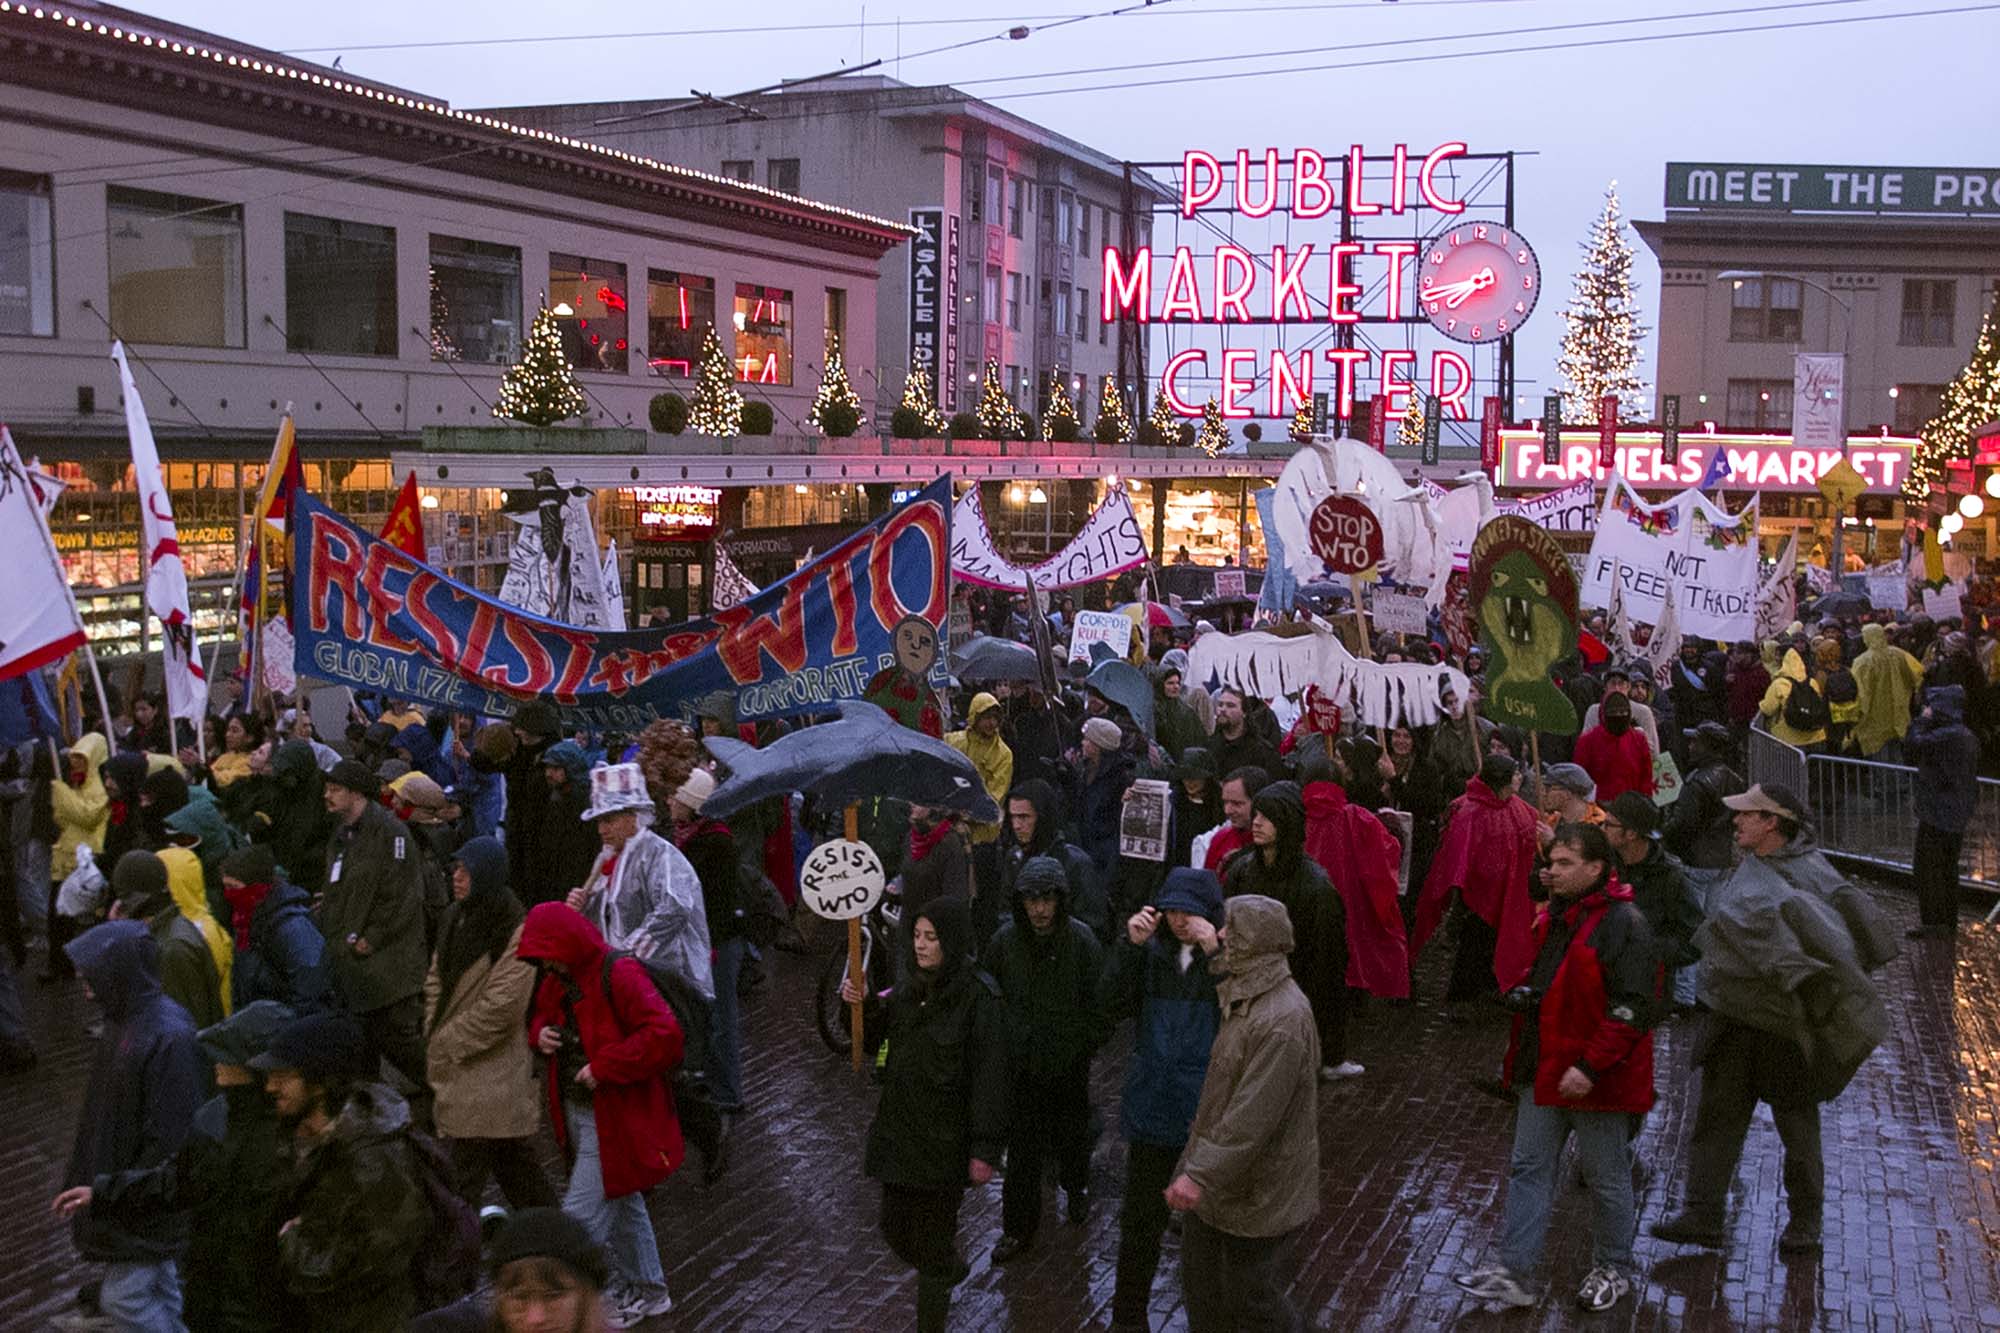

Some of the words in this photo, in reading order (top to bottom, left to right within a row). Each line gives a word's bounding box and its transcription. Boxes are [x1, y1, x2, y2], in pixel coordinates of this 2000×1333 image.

[1182, 142, 1467, 219] PUBLIC
[1687, 169, 1799, 203] MEET
[1824, 172, 1903, 205] THE
[915, 214, 936, 243] LA
[949, 217, 958, 247] LA
[1449, 232, 1460, 247] 11
[1473, 225, 1488, 240] 12
[1501, 231, 1508, 245] 1
[1430, 251, 1444, 264] 10
[1518, 249, 1528, 264] 2
[914, 249, 936, 322] SALLE
[948, 254, 958, 326] SALLE
[1101, 244, 1418, 323] MARKET
[1423, 275, 1434, 289] 9
[1523, 275, 1533, 290] 3
[1429, 301, 1439, 315] 8
[1514, 300, 1525, 313] 4
[1447, 319, 1457, 332] 7
[1471, 325, 1481, 339] 6
[1498, 318, 1507, 332] 5
[946, 333, 957, 406] HOTEL
[1161, 348, 1473, 422] CENTER
[1314, 505, 1374, 541] STOP
[1318, 536, 1370, 568] WTO
[1665, 550, 1706, 580] NOT
[1596, 558, 1666, 600] FREE
[1685, 585, 1751, 617] TRADE
[310, 511, 600, 705] RESIST
[711, 500, 950, 685] WTO
[1077, 627, 1110, 642] RULE
[804, 846, 879, 891] RESIST
[828, 870, 850, 882] THE
[818, 886, 868, 913] WTO
